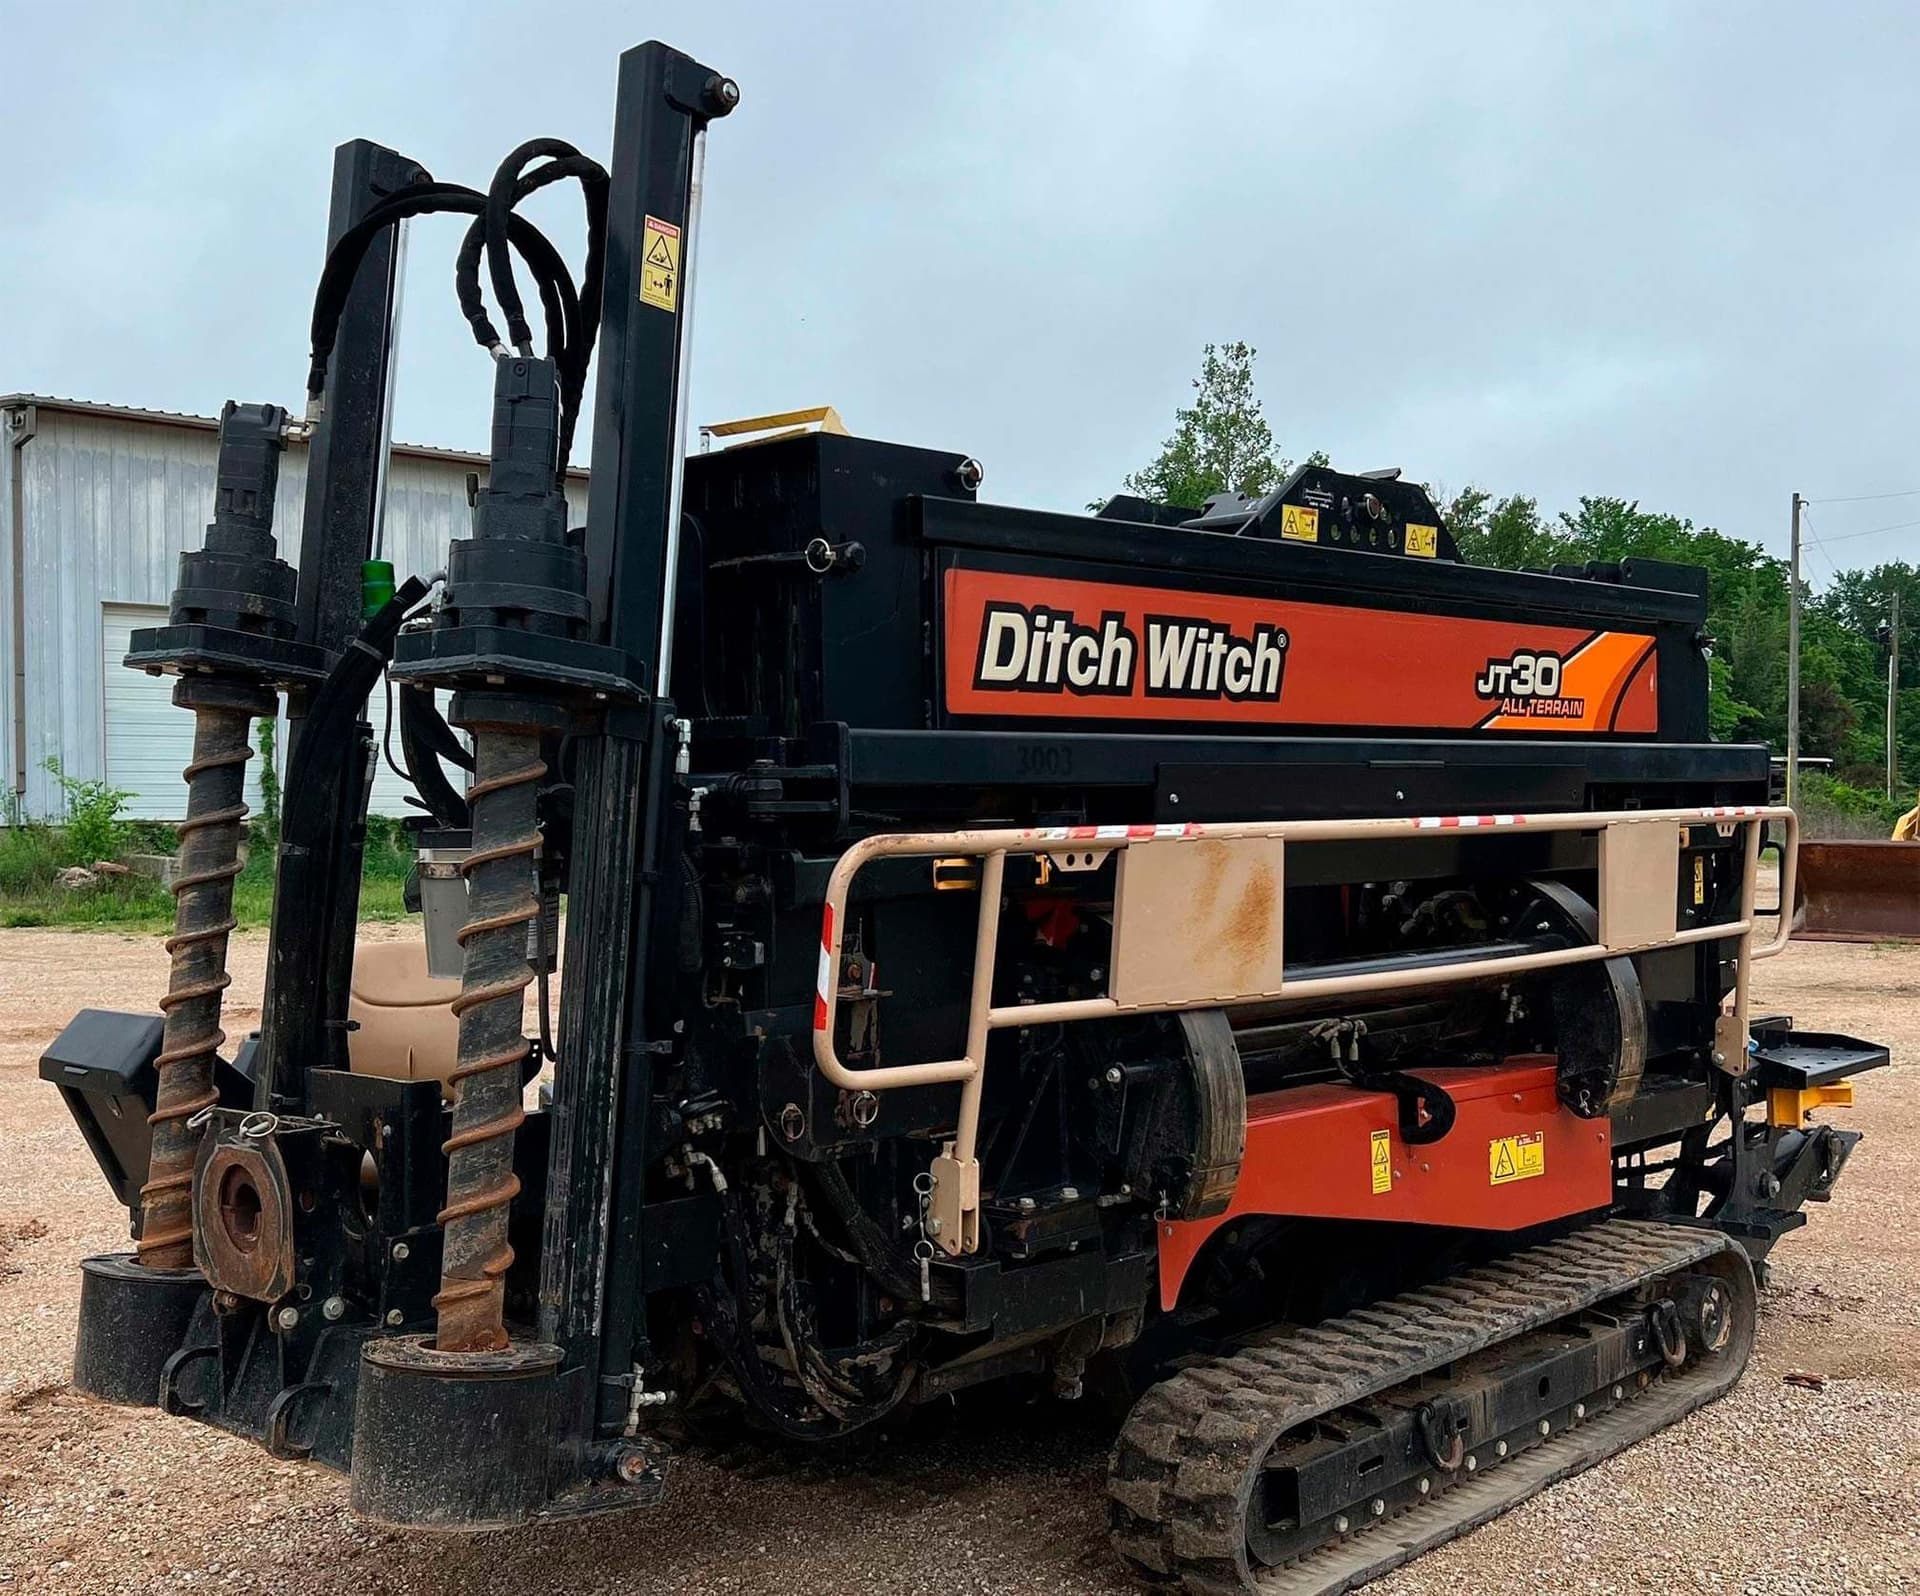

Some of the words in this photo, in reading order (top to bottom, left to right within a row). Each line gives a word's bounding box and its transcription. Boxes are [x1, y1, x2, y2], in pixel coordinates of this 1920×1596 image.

[981, 611, 1133, 687] Ditch
[1478, 655, 1560, 696] JT30
[1501, 698, 1526, 714] ALL
[1529, 699, 1583, 716] TERRAIN
[1016, 744, 1073, 776] 3003
